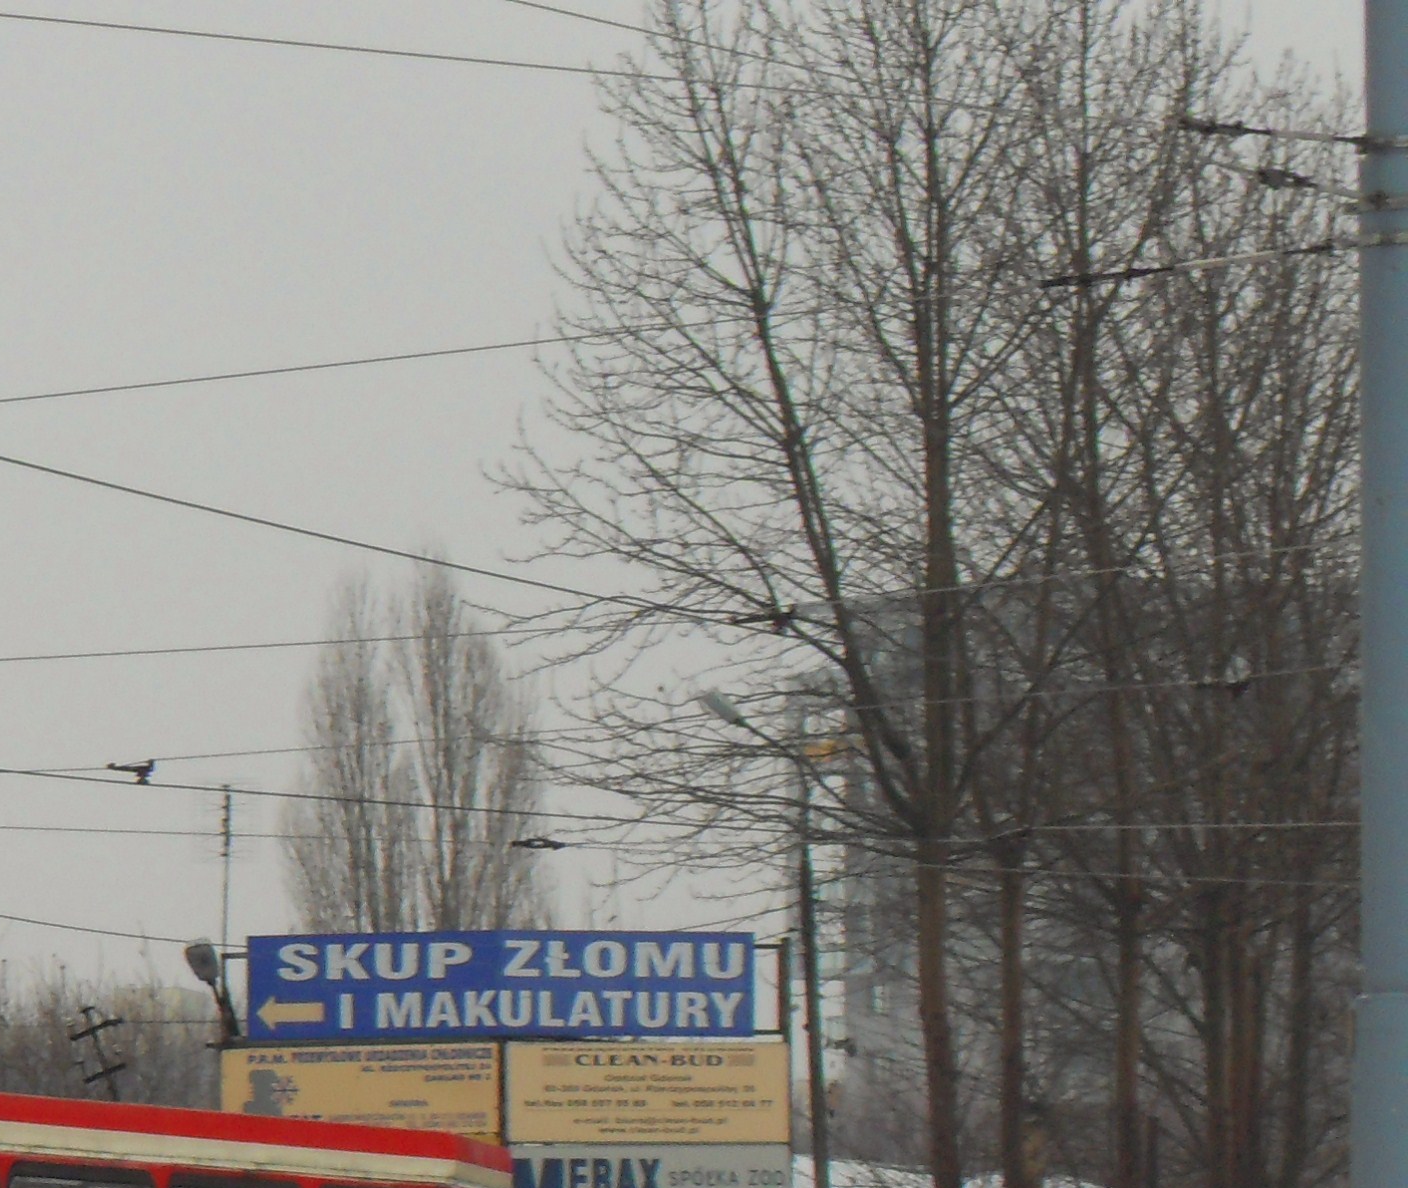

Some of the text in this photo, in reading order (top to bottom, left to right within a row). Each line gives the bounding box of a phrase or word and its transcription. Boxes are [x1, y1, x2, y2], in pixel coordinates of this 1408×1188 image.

[276, 939, 746, 981] SKUP ZŁOMU
[338, 989, 744, 1030] I MAKULATURY
[574, 1053, 724, 1067] CLEAN-BUD
